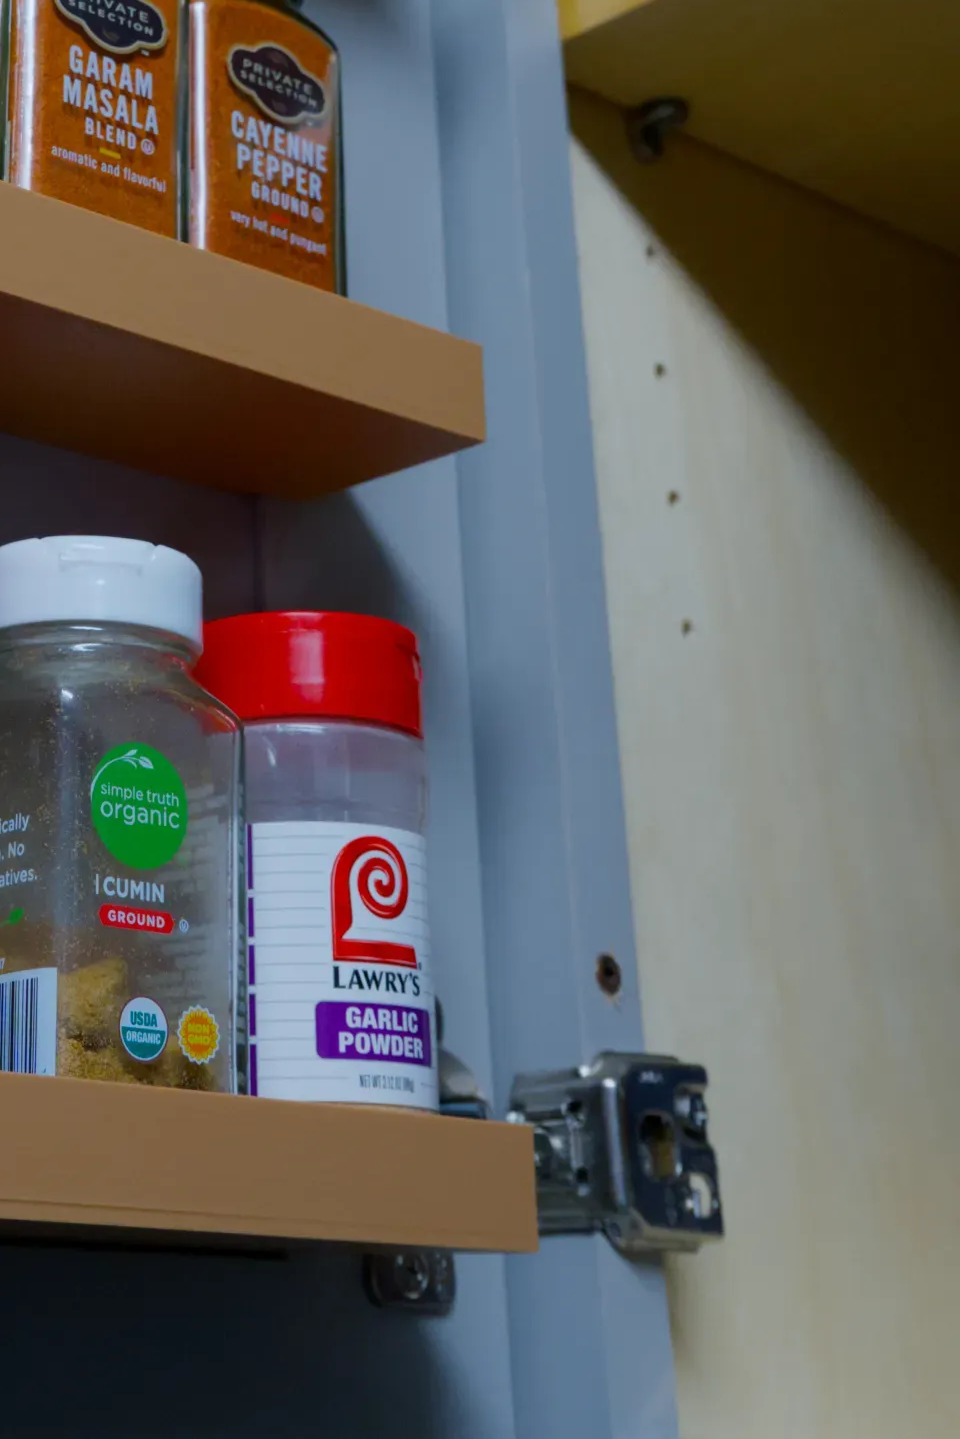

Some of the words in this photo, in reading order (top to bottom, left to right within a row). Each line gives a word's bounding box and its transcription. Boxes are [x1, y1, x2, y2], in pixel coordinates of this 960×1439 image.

[69, 45, 154, 100] GARAM
[243, 58, 313, 95] PRIVATE
[63, 73, 159, 135] MASALA
[240, 69, 318, 108] SELECTION
[85, 117, 137, 150] BLEND
[231, 110, 328, 173] CAYENNE
[51, 145, 97, 170] aromatic
[101, 161, 120, 177] and
[124, 166, 167, 193] flavorful
[236, 142, 322, 202] PEPPER
[251, 181, 309, 219] GROUND
[270, 225, 288, 241] and
[100, 782, 144, 802] simple
[146, 789, 180, 807] truth
[100, 799, 180, 830] organic
[8, 842, 25, 859] No
[103, 876, 165, 904] CUMIN
[107, 909, 166, 929] GROUND
[333, 965, 421, 997] LAWRY'S
[130, 1010, 158, 1028] USDA
[187, 1023, 210, 1033] NON
[346, 1006, 419, 1035] GARLIC
[126, 1030, 161, 1045] ORGANIC
[338, 1032, 424, 1059] POWDER
